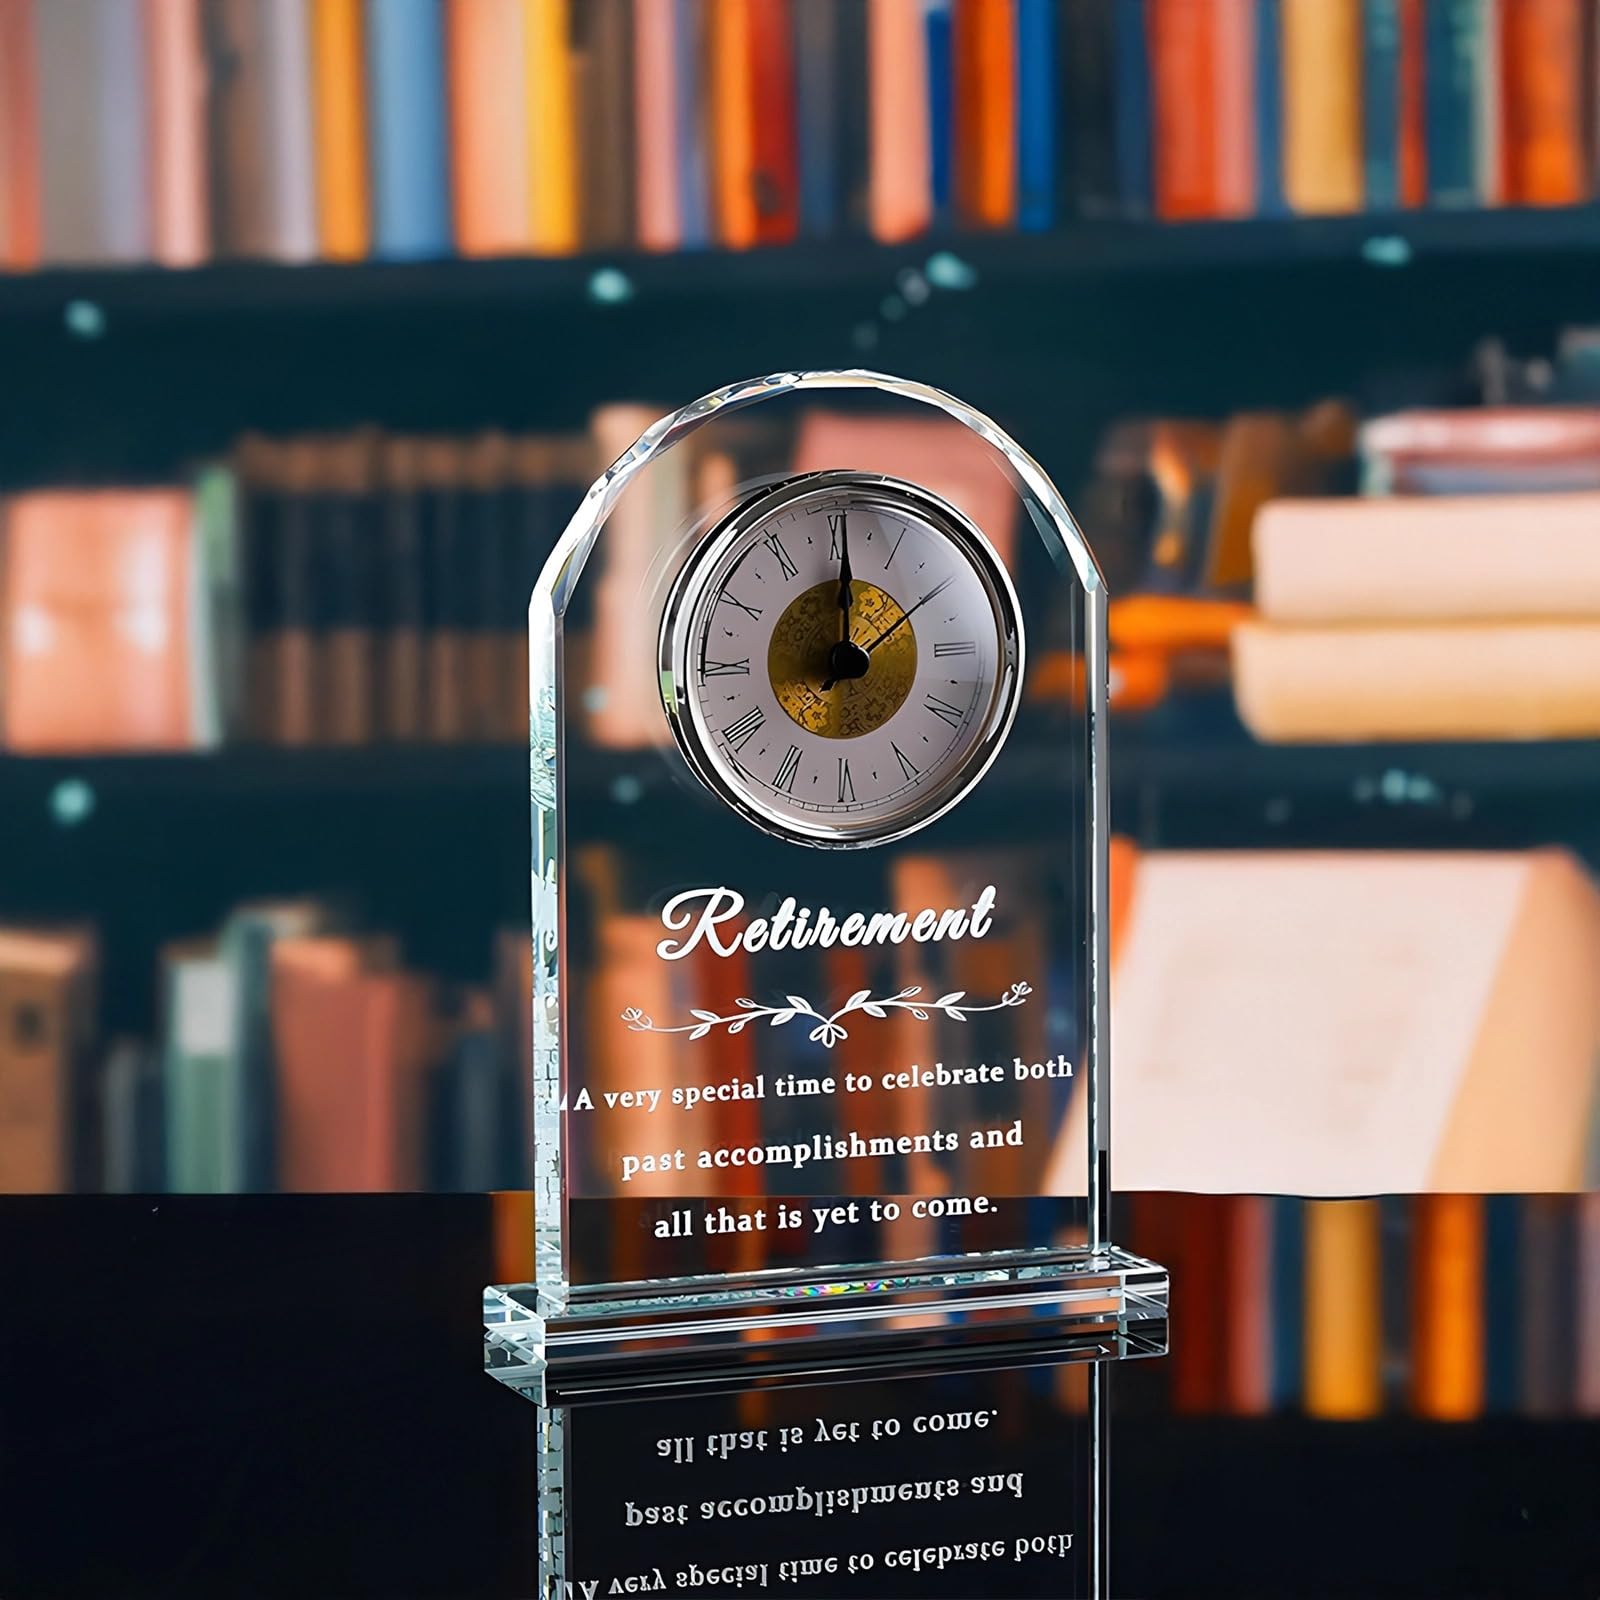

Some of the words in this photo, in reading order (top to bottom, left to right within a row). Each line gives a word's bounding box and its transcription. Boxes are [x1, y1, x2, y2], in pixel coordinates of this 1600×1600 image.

[763, 533, 799, 581] XI
[827, 513, 847, 560] XI
[719, 590, 763, 621] X
[704, 658, 750, 678] IX
[933, 640, 976, 658] III
[721, 705, 766, 754] VIII
[923, 693, 965, 729] IV
[772, 744, 804, 794] VII
[837, 757, 856, 803] VI
[890, 741, 920, 781] V
[655, 885, 997, 961] Retirement
[573, 1087, 595, 1111] A
[603, 1088, 663, 1113] very
[671, 1074, 766, 1111] special
[774, 1074, 836, 1098] time
[844, 1072, 873, 1092] to
[881, 1062, 1005, 1090] celebrate
[1013, 1054, 1074, 1081] both
[621, 1149, 686, 1182] past
[696, 1129, 959, 1170] accomplishments
[969, 1119, 1024, 1150] and
[653, 1210, 693, 1239] all
[704, 1207, 767, 1235] that
[778, 1204, 802, 1229] is
[812, 1201, 860, 1234] yet
[869, 1199, 901, 1222] to
[912, 1195, 998, 1219] come.
